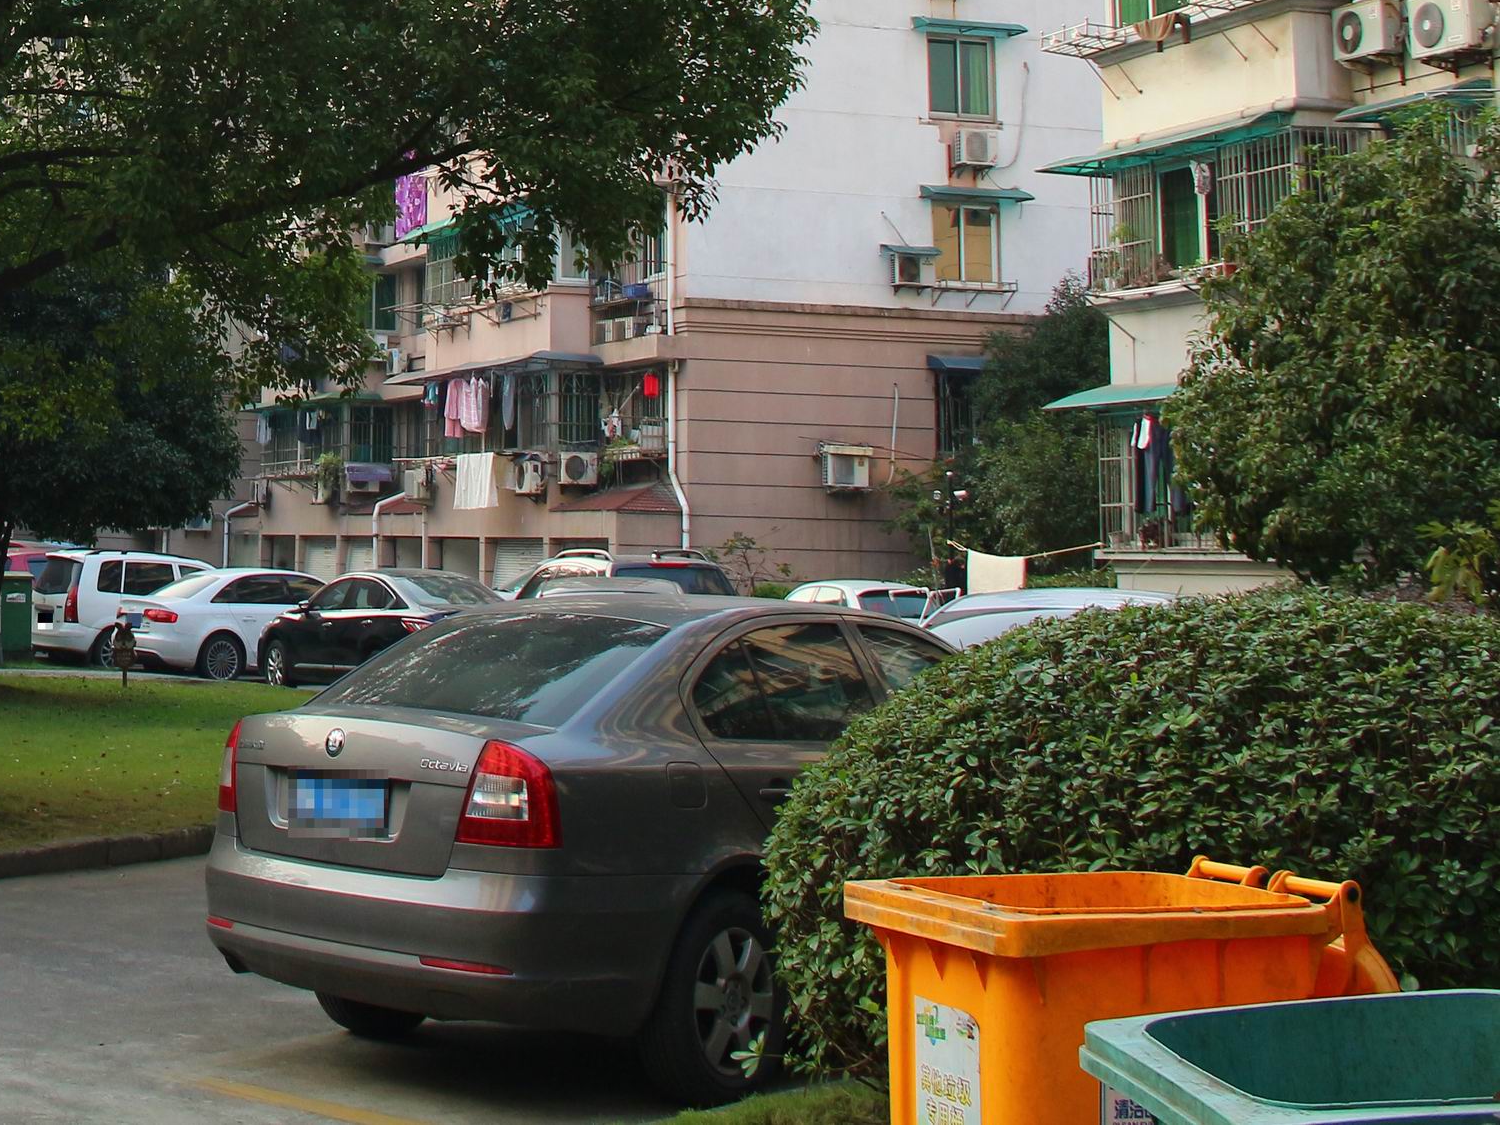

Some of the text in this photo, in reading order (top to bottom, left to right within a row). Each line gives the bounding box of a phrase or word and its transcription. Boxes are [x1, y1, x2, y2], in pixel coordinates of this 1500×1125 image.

[420, 758, 469, 773] Octavia
[921, 1063, 972, 1107] 其他垃圾
